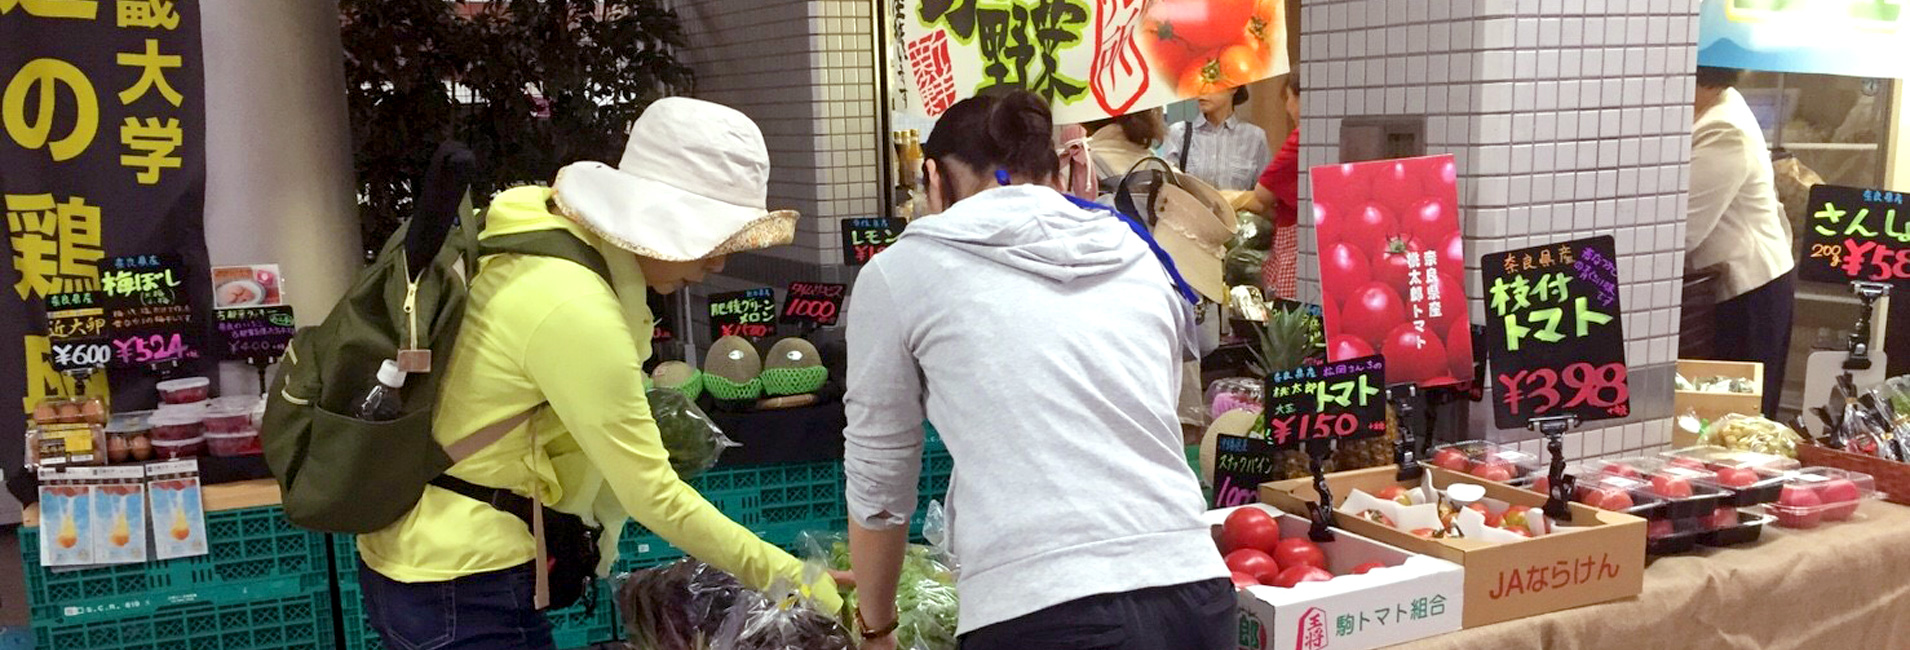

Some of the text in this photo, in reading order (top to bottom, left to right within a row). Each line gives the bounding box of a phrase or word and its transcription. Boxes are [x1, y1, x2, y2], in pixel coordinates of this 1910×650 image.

[851, 229, 899, 245] レモン
[1503, 245, 1576, 273] 奈良県産
[102, 268, 181, 297] 梅ぼし
[1423, 250, 1442, 317] 奈良県産
[1489, 272, 1574, 316] 枝付
[786, 299, 836, 317] 1000
[1406, 251, 1426, 349] 桃太郎トマト
[49, 316, 106, 338] 近大卵
[740, 311, 775, 324] メロン
[1504, 296, 1613, 351] トマト
[52, 344, 111, 366] ¥600
[113, 333, 189, 363] ¥524
[1316, 374, 1379, 413] トマト
[1498, 362, 1630, 415] ¥398
[1271, 413, 1359, 444] ¥150
[1488, 552, 1621, 600] JAならけん
[1305, 613, 1325, 650] 王将
[1335, 594, 1447, 637] 駒トマト組合
